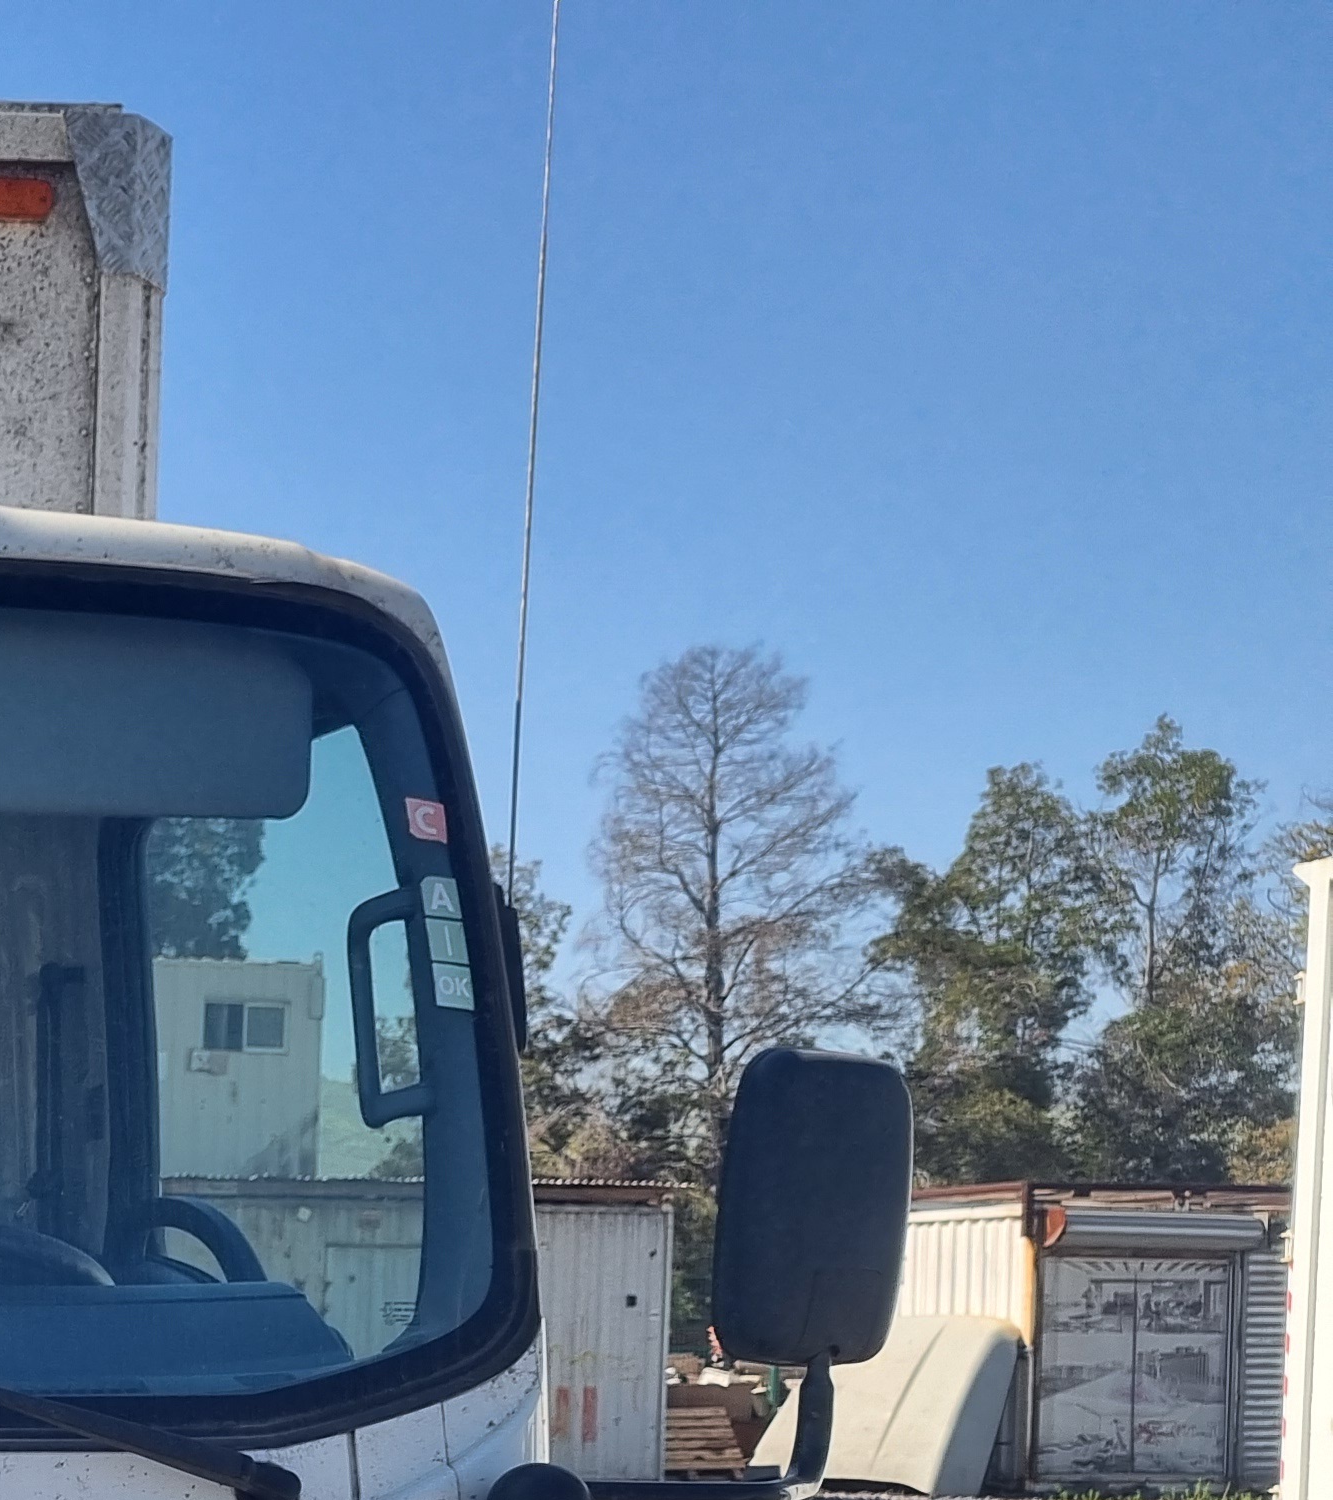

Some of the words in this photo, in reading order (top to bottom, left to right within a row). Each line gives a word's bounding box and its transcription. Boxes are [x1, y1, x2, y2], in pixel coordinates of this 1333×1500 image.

[414, 806, 437, 835] C
[430, 883, 456, 912] A
[438, 976, 470, 998] OK
